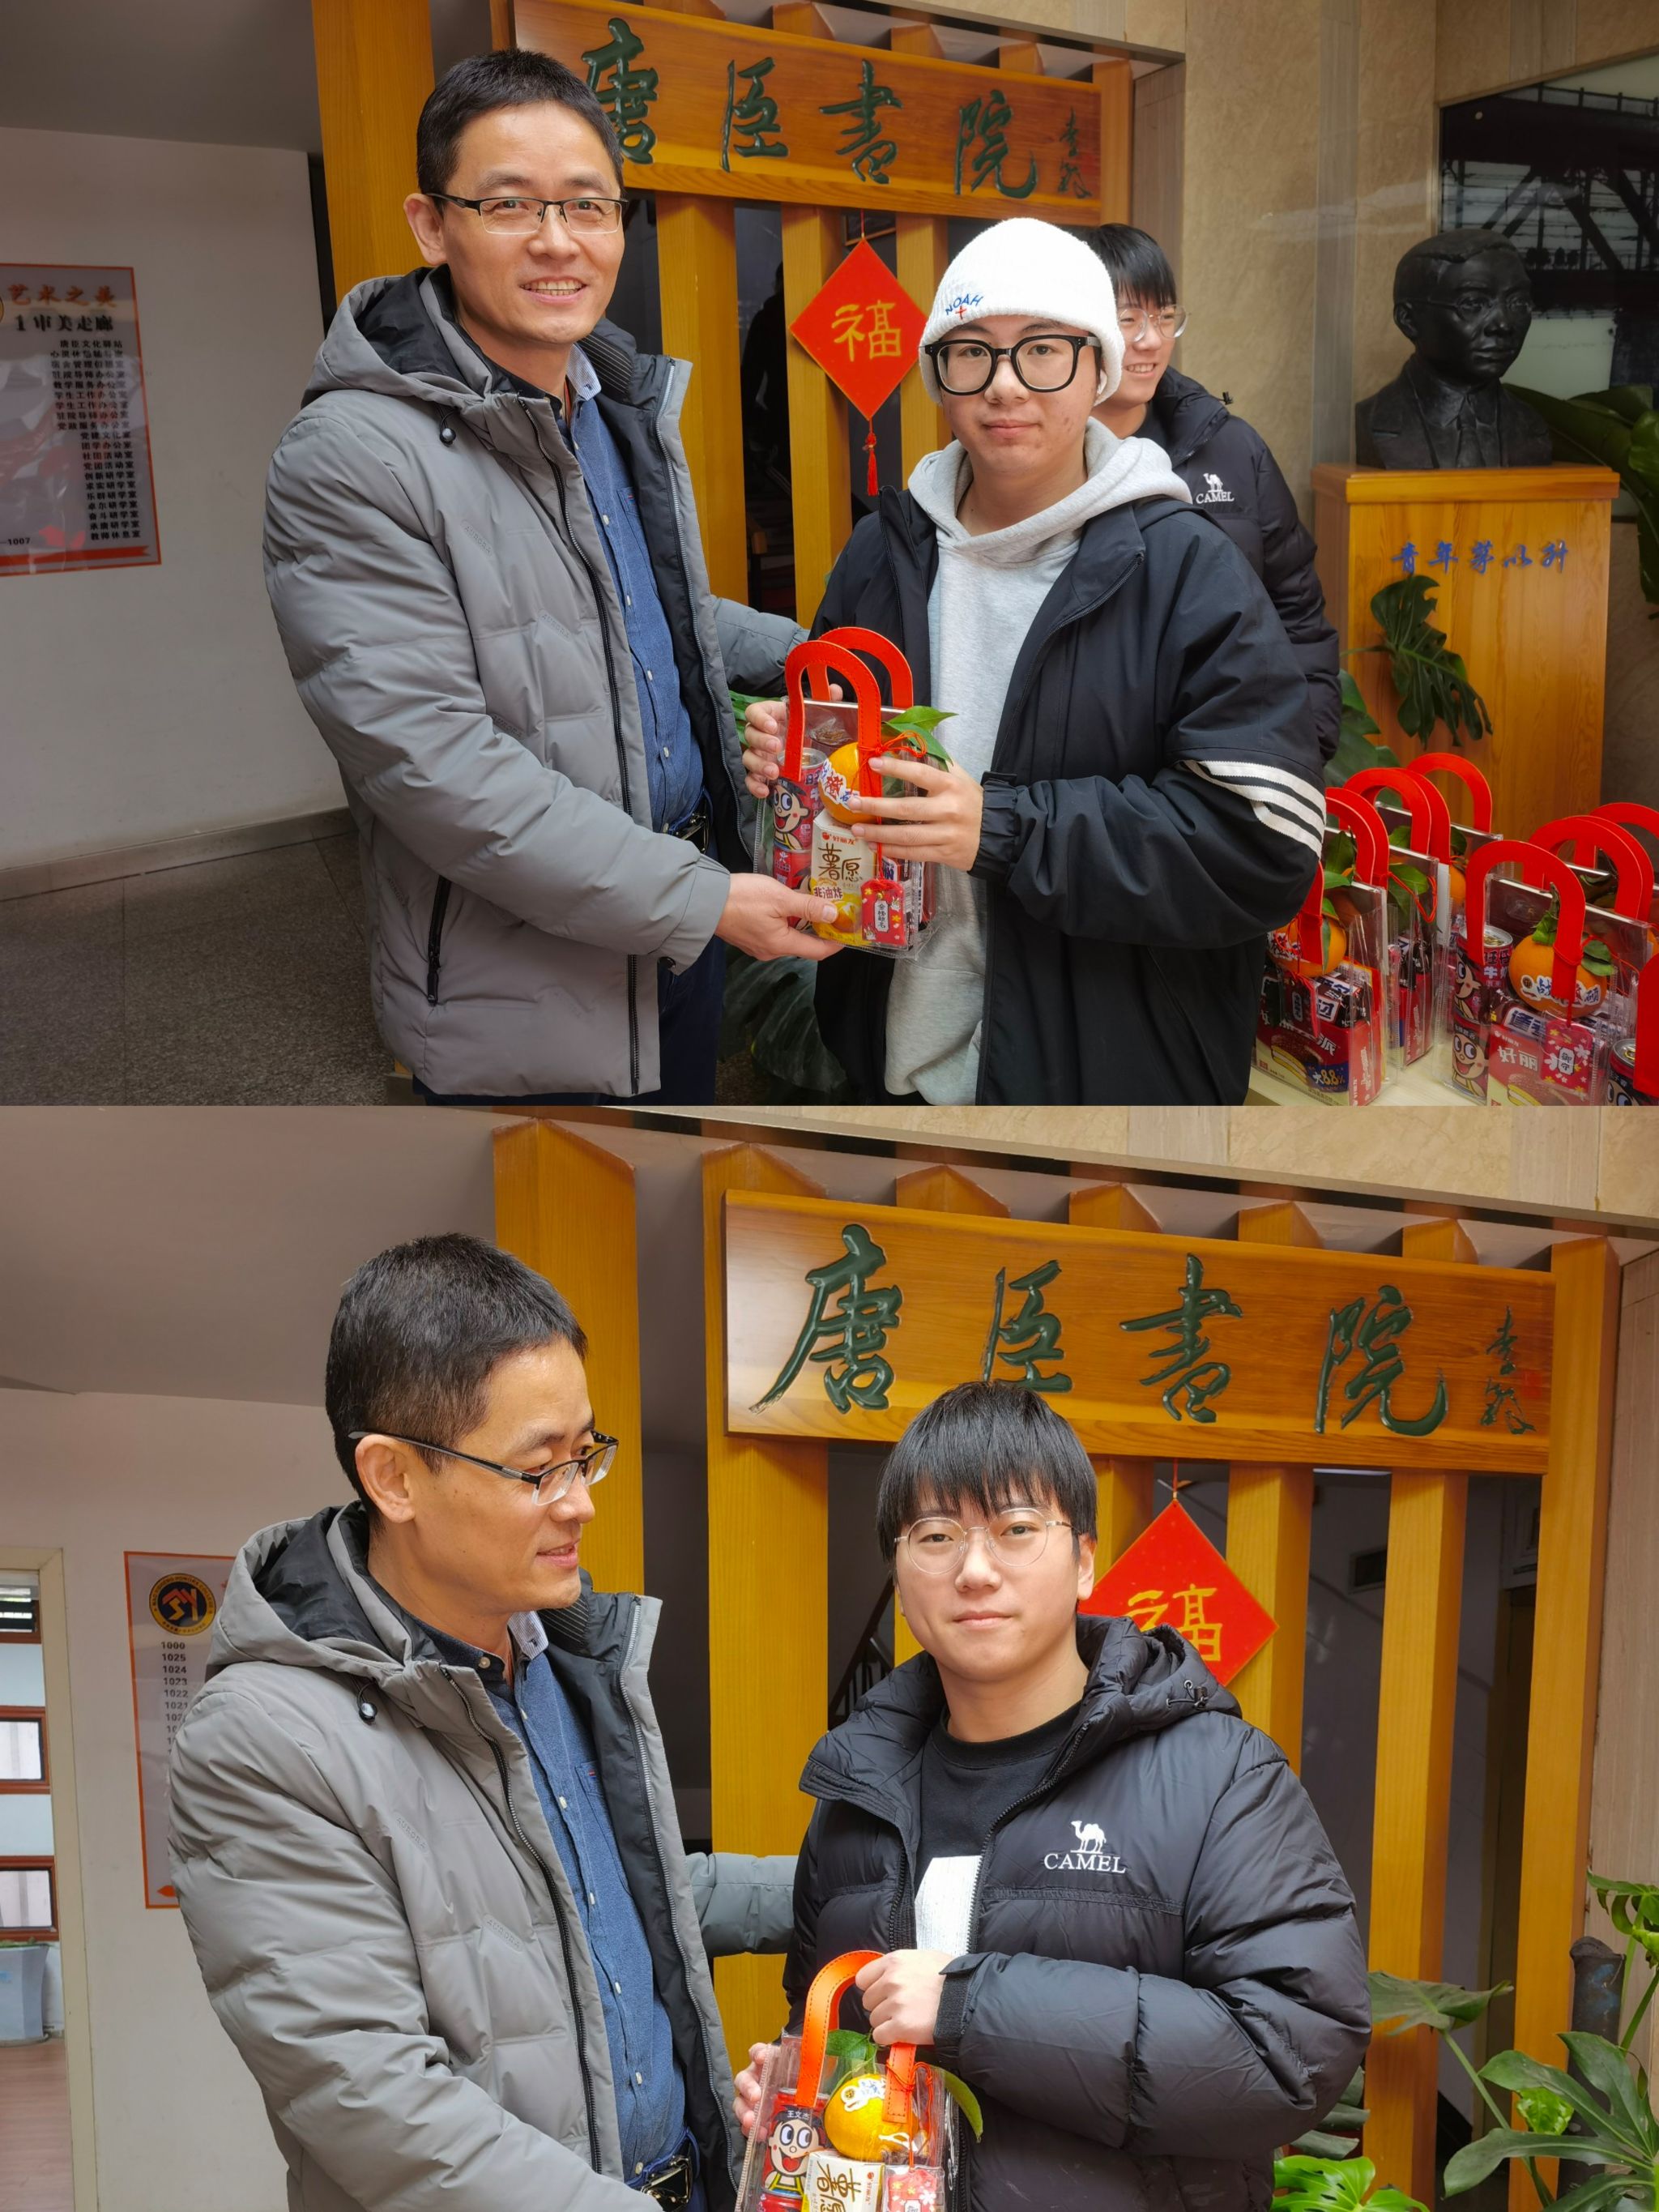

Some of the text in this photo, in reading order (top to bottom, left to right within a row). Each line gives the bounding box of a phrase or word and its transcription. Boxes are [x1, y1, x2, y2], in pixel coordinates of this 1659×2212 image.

[945, 293, 983, 315] NOAH
[832, 301, 901, 361] 福
[1196, 491, 1235, 504] CAMEL
[818, 843, 864, 882] 薯愿
[813, 886, 843, 899] 非油炸
[160, 1642, 186, 1650] 1000
[161, 1653, 186, 1662] 1025
[162, 1665, 187, 1674] 1024
[163, 1677, 188, 1686] 1023
[164, 1689, 189, 1698] 1022
[1043, 1853, 1126, 1873] CAMEL
